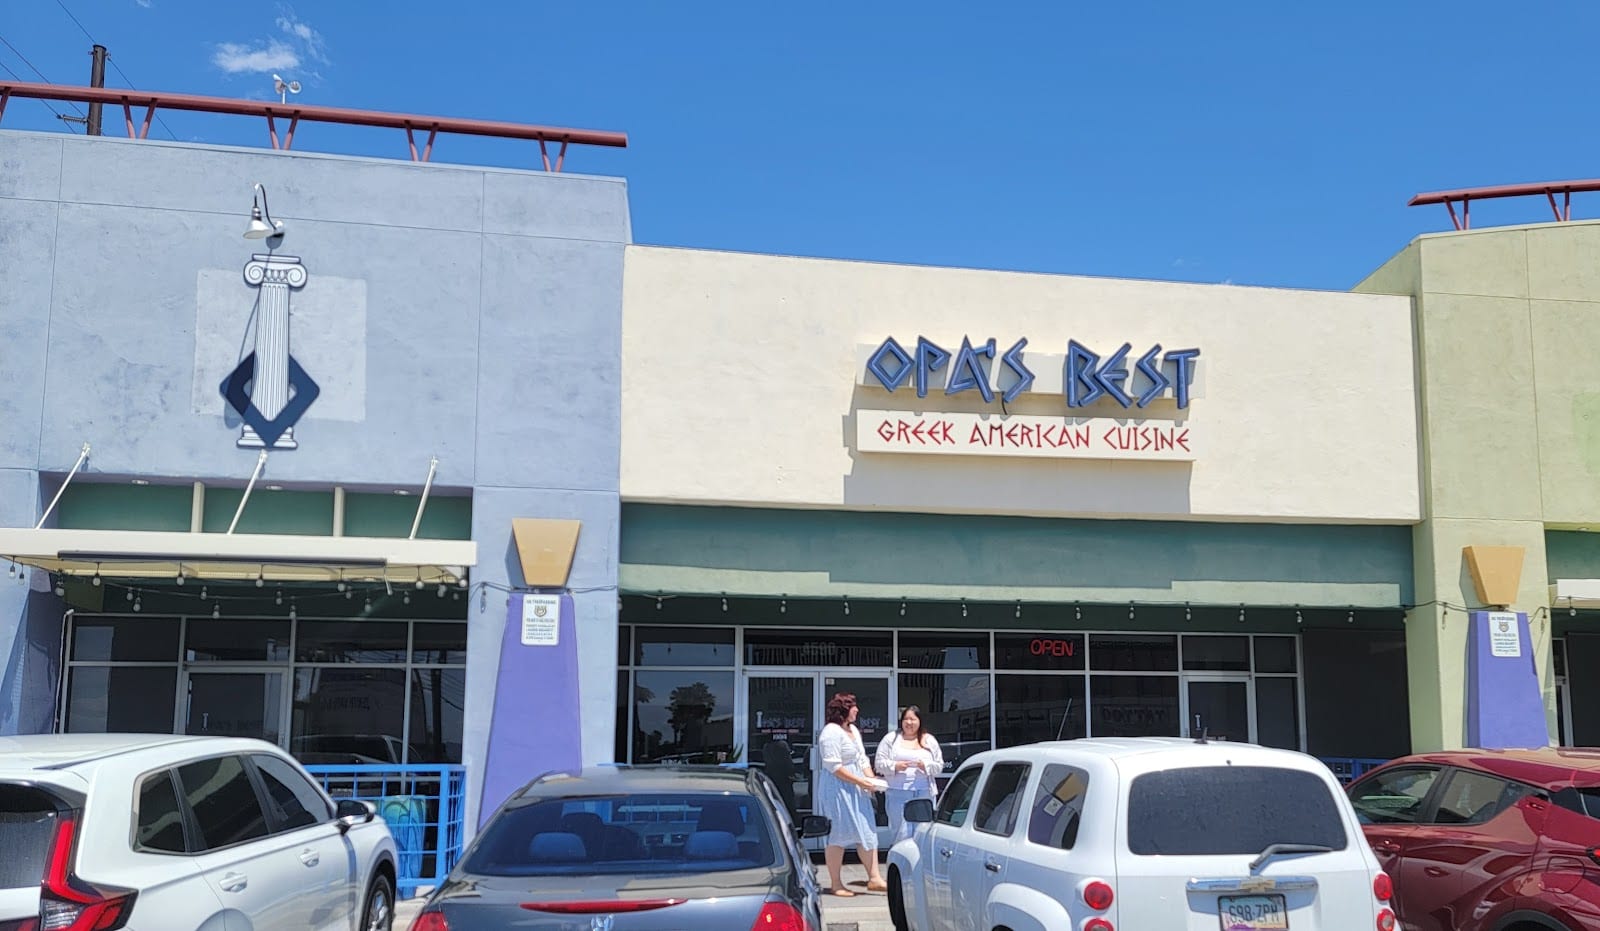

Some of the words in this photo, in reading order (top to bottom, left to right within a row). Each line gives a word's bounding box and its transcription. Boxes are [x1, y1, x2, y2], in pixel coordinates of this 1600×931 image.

[866, 334, 1035, 404] OPA'S
[1067, 338, 1201, 409] BEST
[876, 419, 955, 446] GREEK
[969, 422, 1090, 449] AMERICAN
[1103, 425, 1191, 452] CUISINE
[1030, 639, 1074, 657] OPEN
